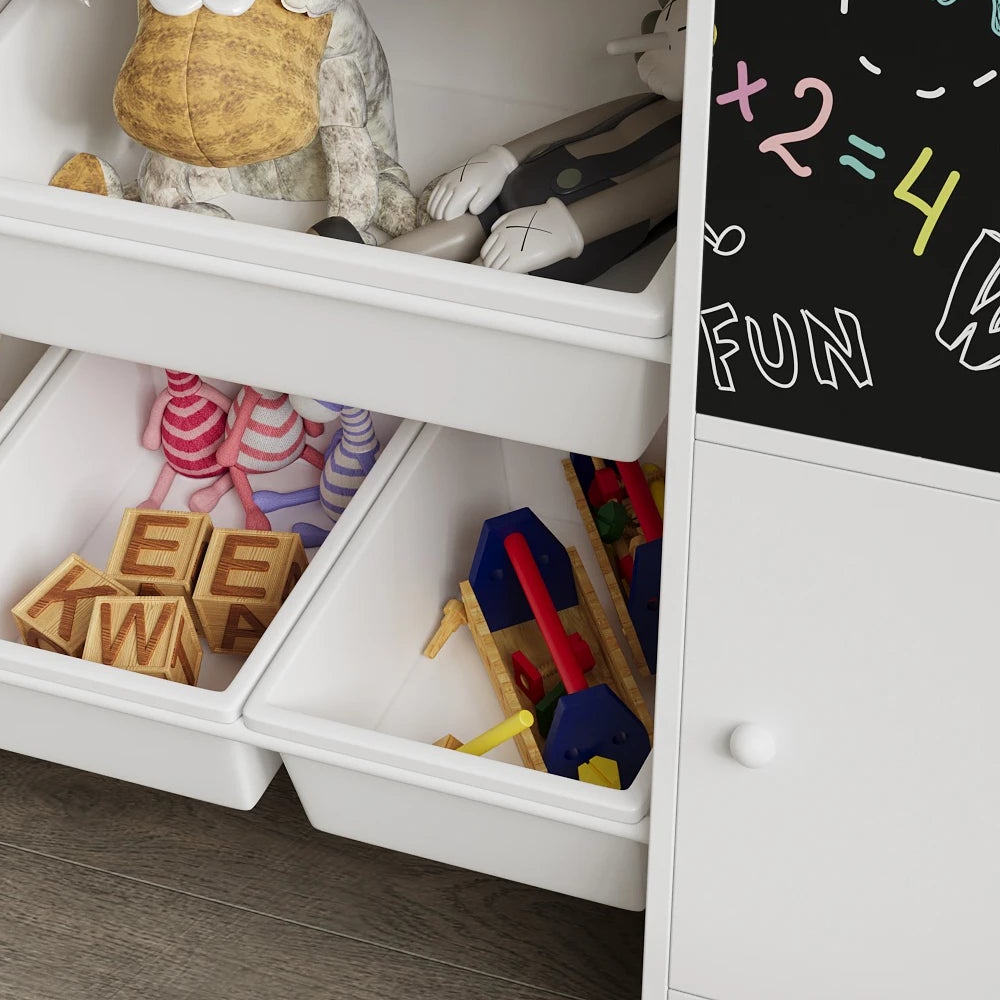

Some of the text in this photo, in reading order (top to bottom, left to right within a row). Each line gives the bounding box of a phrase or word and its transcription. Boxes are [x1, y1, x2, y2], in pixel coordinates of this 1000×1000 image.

[700, 301, 873, 392] FUN
[120, 514, 190, 577] E
[210, 534, 280, 598] E
[27, 564, 118, 642] K
[99, 602, 176, 666] W
